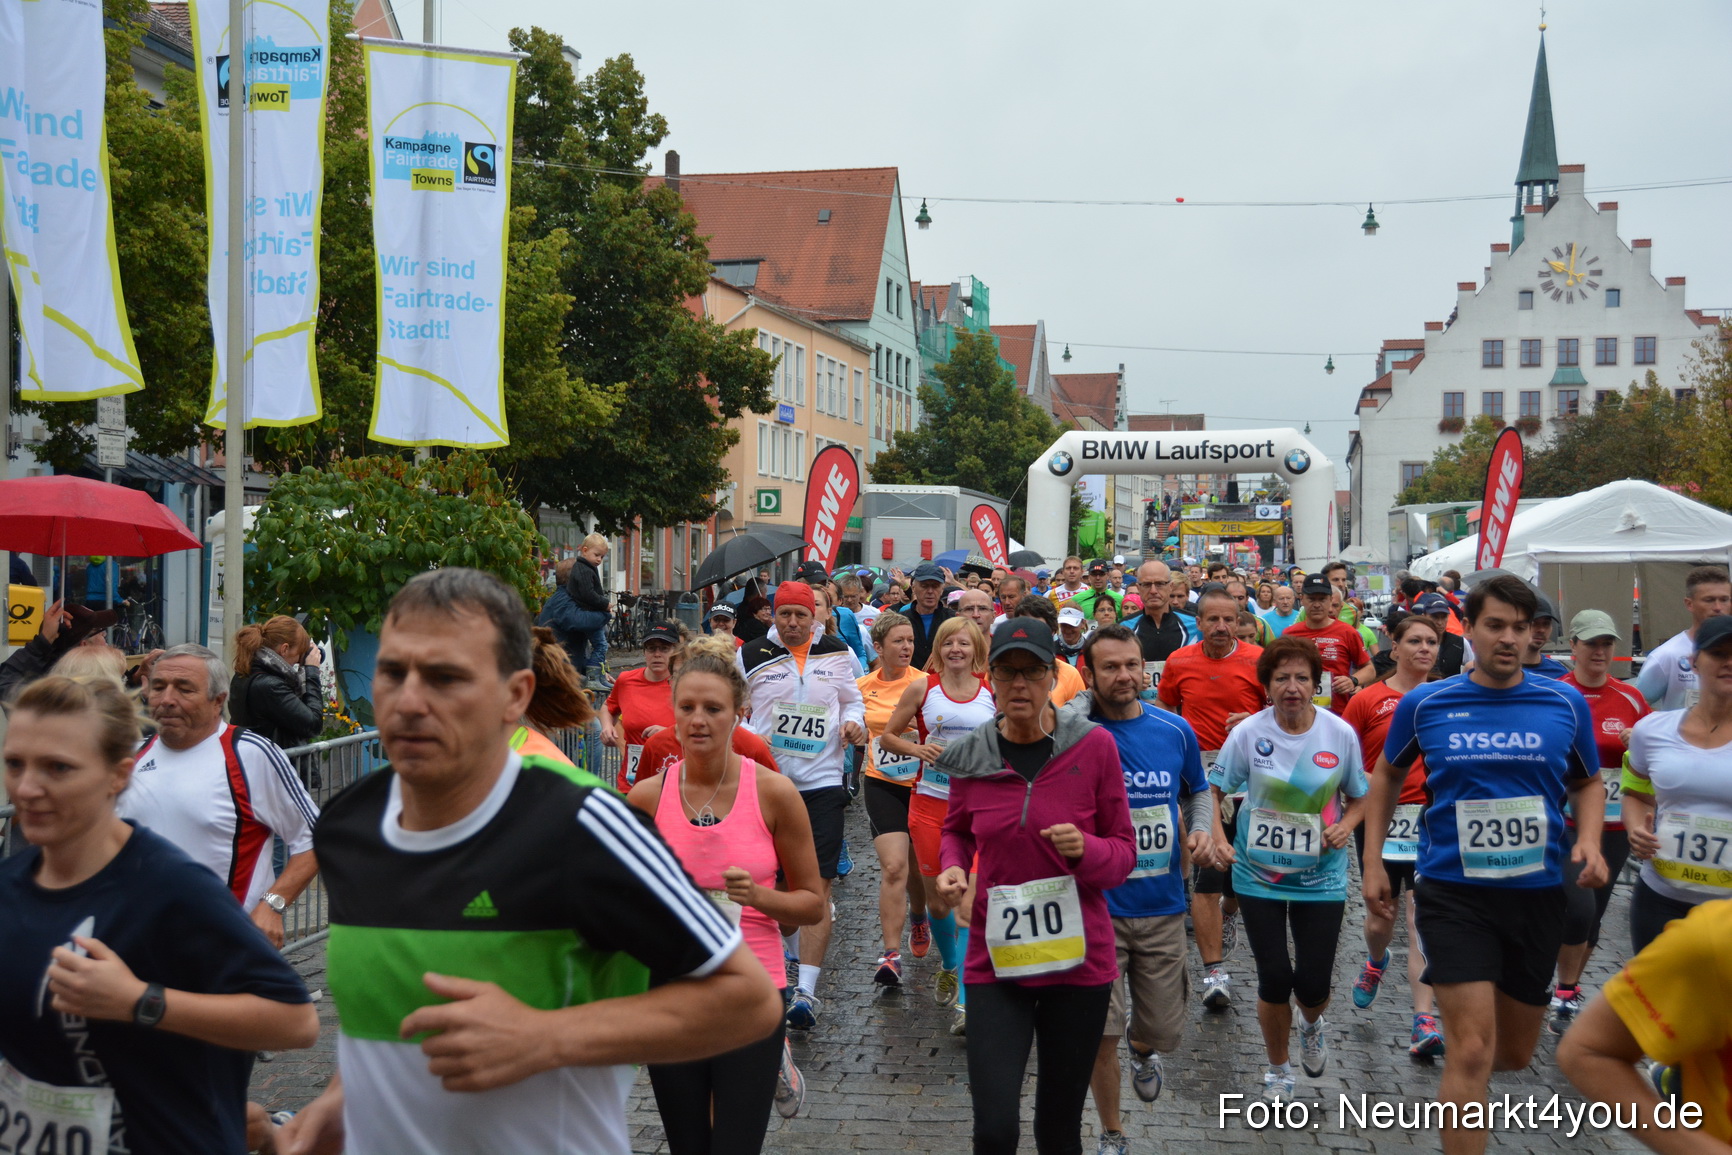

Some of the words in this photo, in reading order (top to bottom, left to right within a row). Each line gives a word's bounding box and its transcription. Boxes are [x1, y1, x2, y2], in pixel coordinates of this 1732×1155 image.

[385, 138, 452, 154] Kampagne
[385, 150, 459, 169] Fairtrade
[413, 173, 453, 186] Towns
[465, 175, 495, 185] FAIRTRADE
[380, 254, 419, 277] Wir
[426, 257, 475, 280] sind
[383, 287, 494, 312] Fairtrade-
[388, 319, 450, 340] Stadt!
[1082, 440, 1149, 460] BMW
[1156, 440, 1275, 464] Laufsport
[760, 493, 777, 510] D
[1480, 449, 1518, 571] REWE
[1221, 524, 1243, 533] ZIEL
[711, 604, 735, 614] adidas
[777, 714, 825, 739] 2745
[784, 739, 814, 752] Rüdiger
[1448, 732, 1542, 750] SYSCAD
[1254, 758, 1274, 766] PARTL
[1445, 752, 1546, 762] www.metallbau-cad.de
[1124, 771, 1171, 787] SCAD
[1133, 823, 1167, 850] 06
[1255, 823, 1311, 852] 2611
[1467, 816, 1540, 848] 2395
[1673, 831, 1729, 865] 137
[1272, 855, 1292, 865] Liba
[1487, 855, 1524, 867] Fabian
[1681, 868, 1708, 882] Alex
[1022, 881, 1068, 897] BOCK
[1002, 901, 1063, 941] 210
[1003, 947, 1038, 962] Susi
[0, 1101, 92, 1155] 2240
